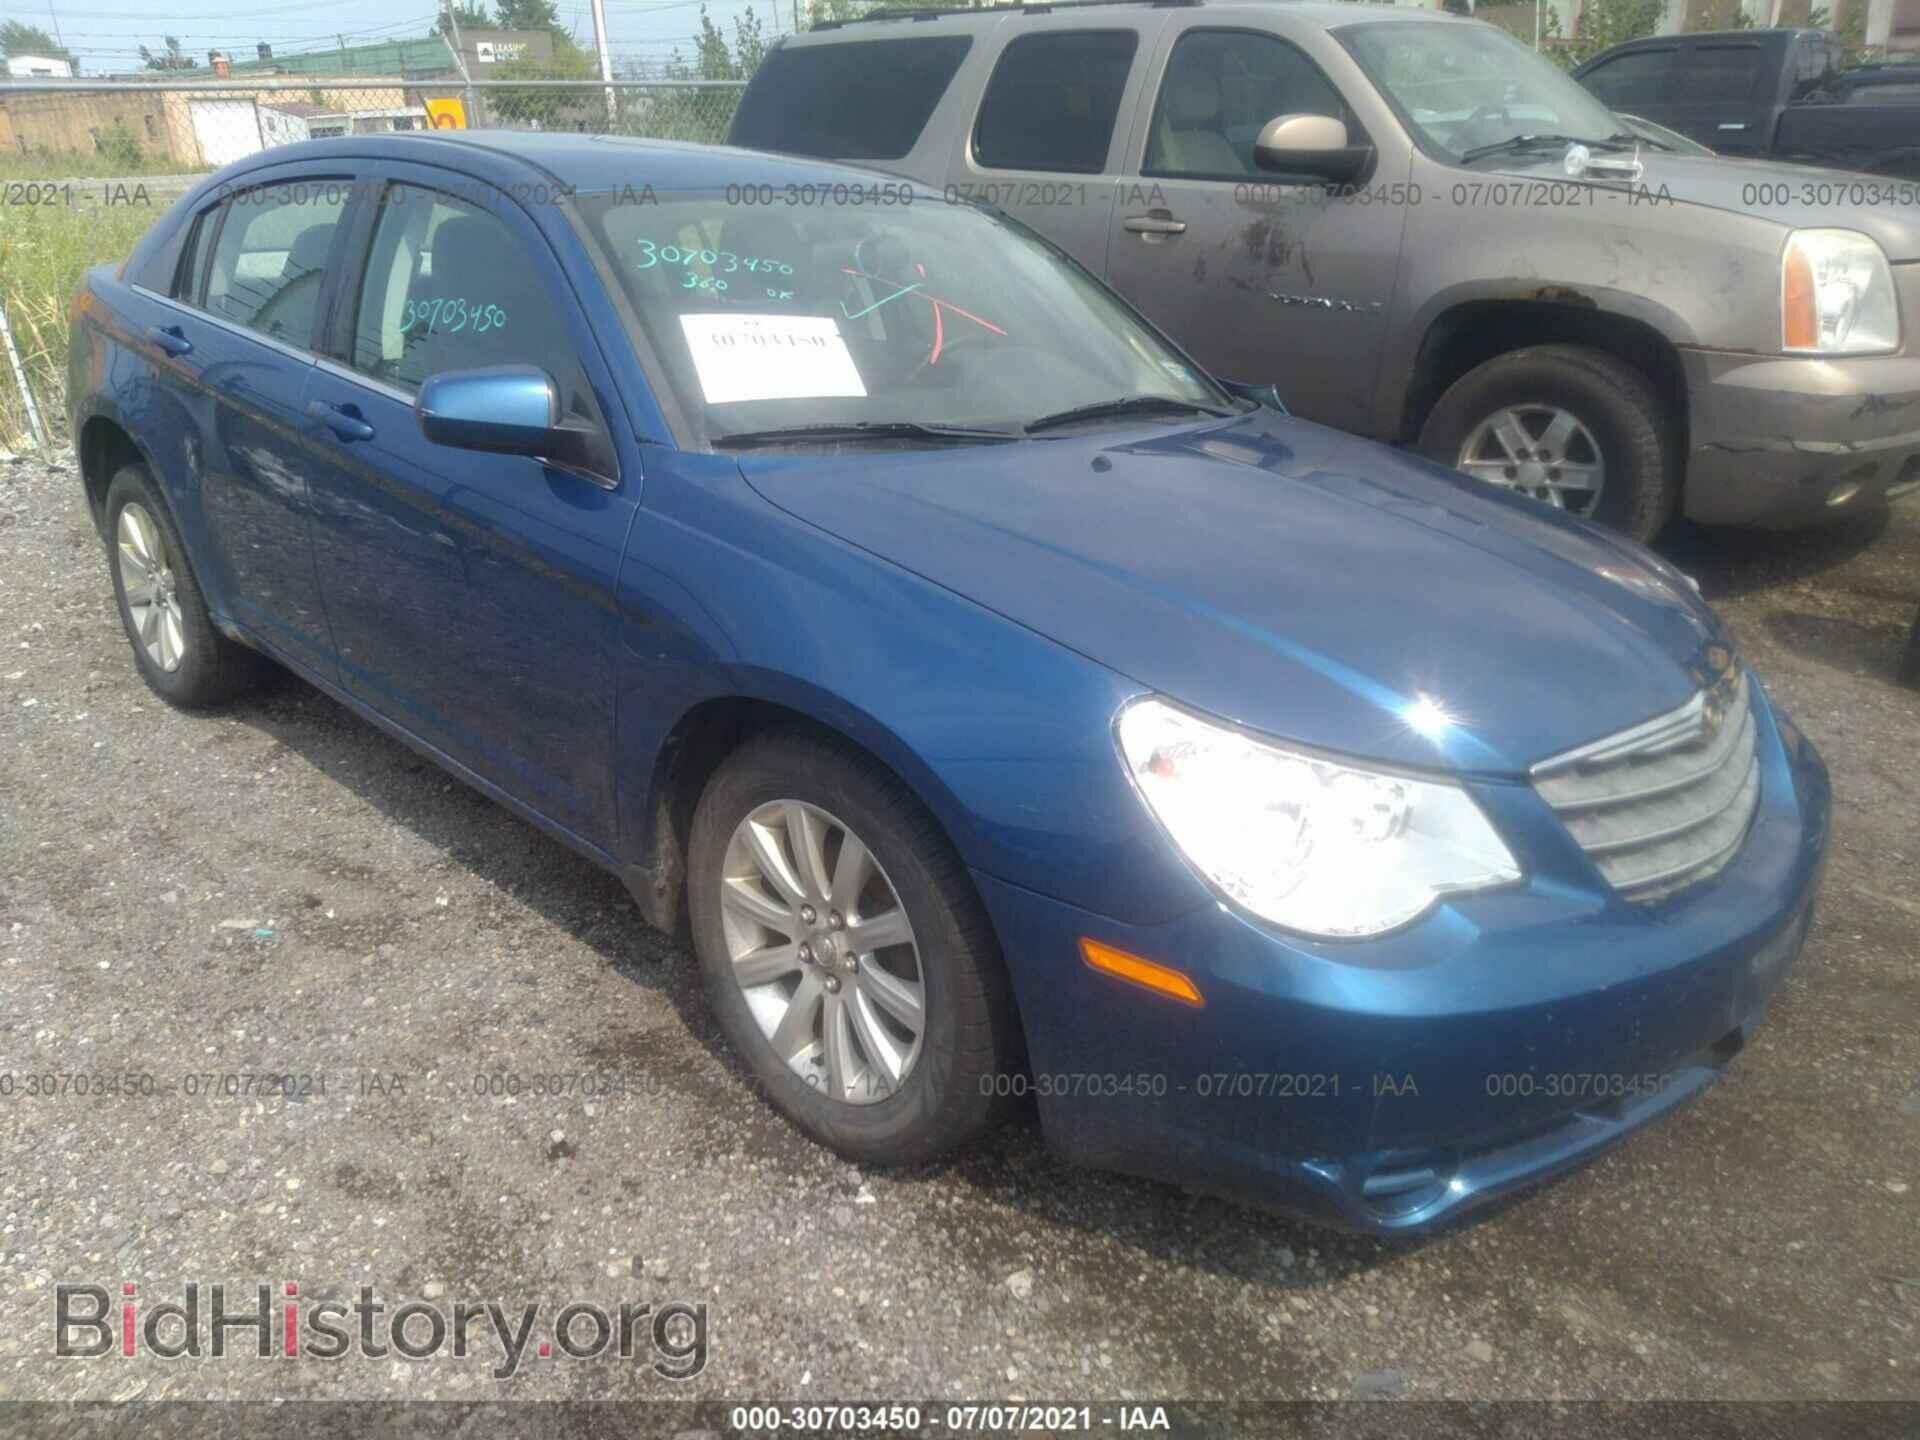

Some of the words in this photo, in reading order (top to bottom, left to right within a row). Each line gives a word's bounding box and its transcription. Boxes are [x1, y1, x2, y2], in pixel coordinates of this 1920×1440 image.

[637, 239, 793, 275] 30703450
[682, 271, 728, 291] 360
[400, 298, 506, 335] 30703450
